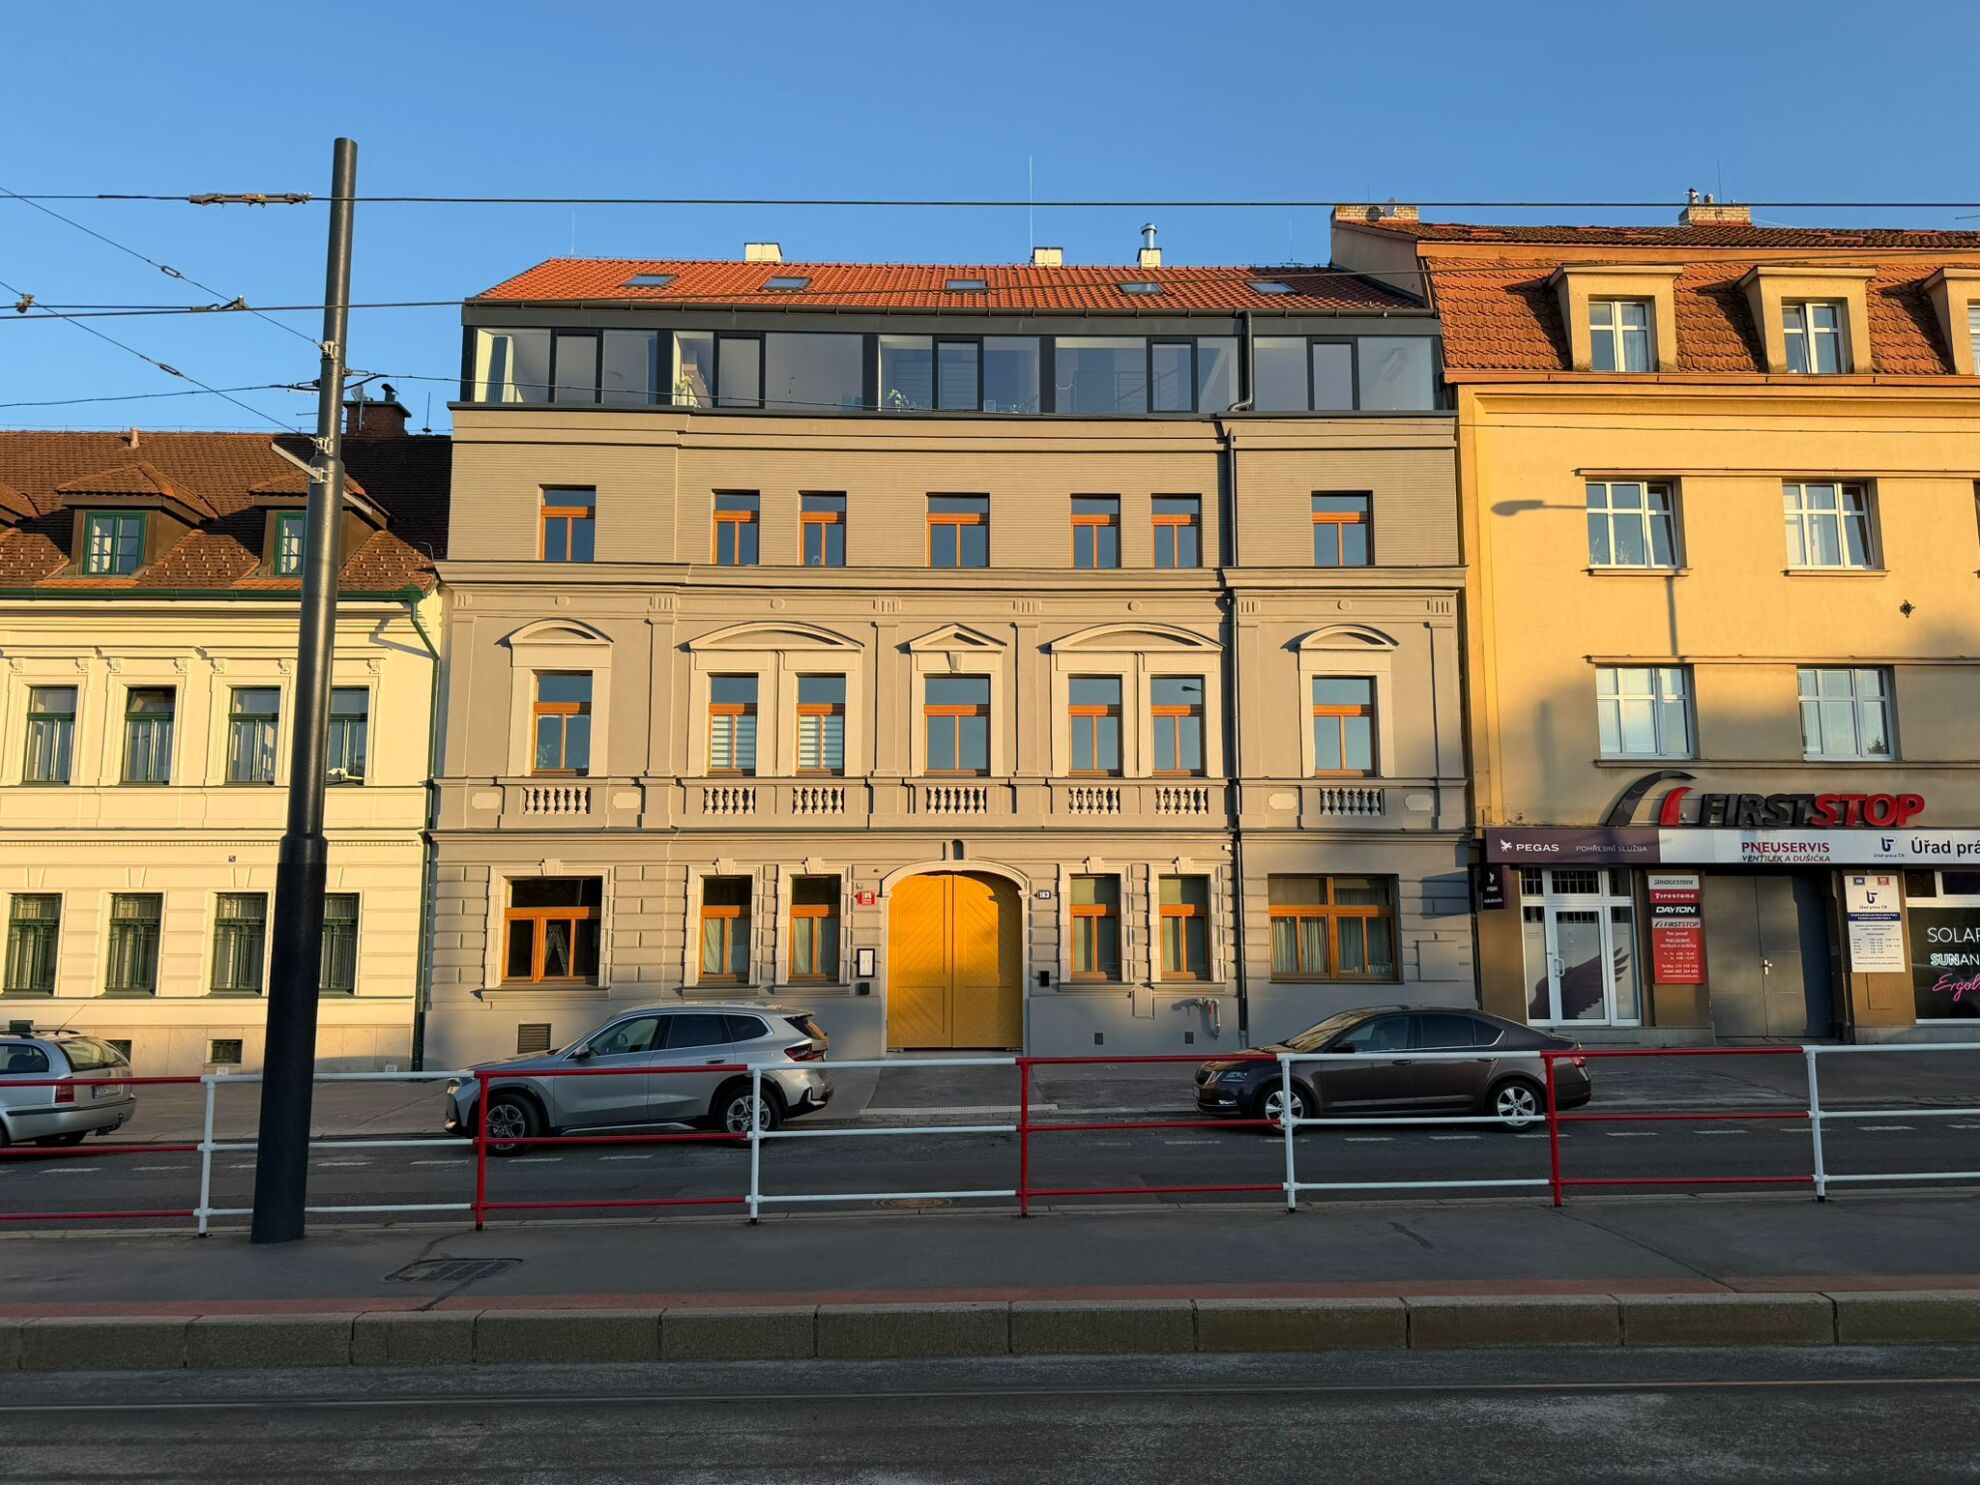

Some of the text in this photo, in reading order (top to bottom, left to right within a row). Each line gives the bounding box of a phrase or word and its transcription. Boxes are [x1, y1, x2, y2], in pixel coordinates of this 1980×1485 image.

[1701, 793, 1925, 827] FIRSTSTOP
[1516, 843, 1560, 852] PEGAS
[1741, 842, 1830, 853] PNEUSERVIS
[1911, 836, 1980, 857] Úřad prá
